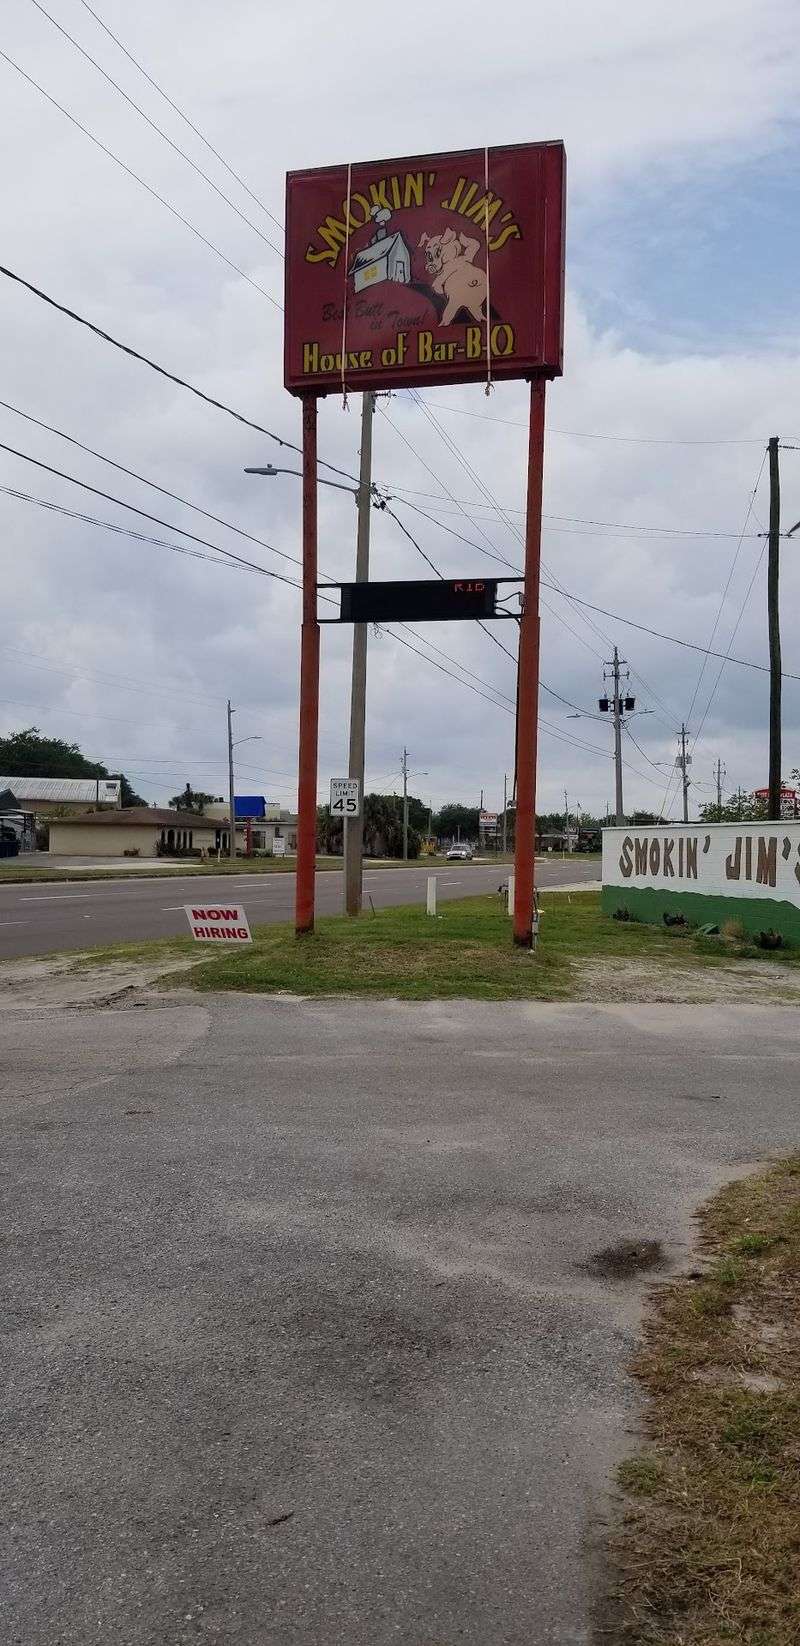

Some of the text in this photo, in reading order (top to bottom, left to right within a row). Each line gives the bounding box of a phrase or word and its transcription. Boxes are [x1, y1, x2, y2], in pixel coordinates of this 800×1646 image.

[305, 172, 522, 268] SMOKIN' JIM'S
[303, 324, 516, 373] House of Bar-B-Q
[333, 798, 357, 812] 45
[619, 834, 711, 879] SMOKIN'
[192, 909, 238, 921] NOW
[193, 927, 249, 939] HIRING
